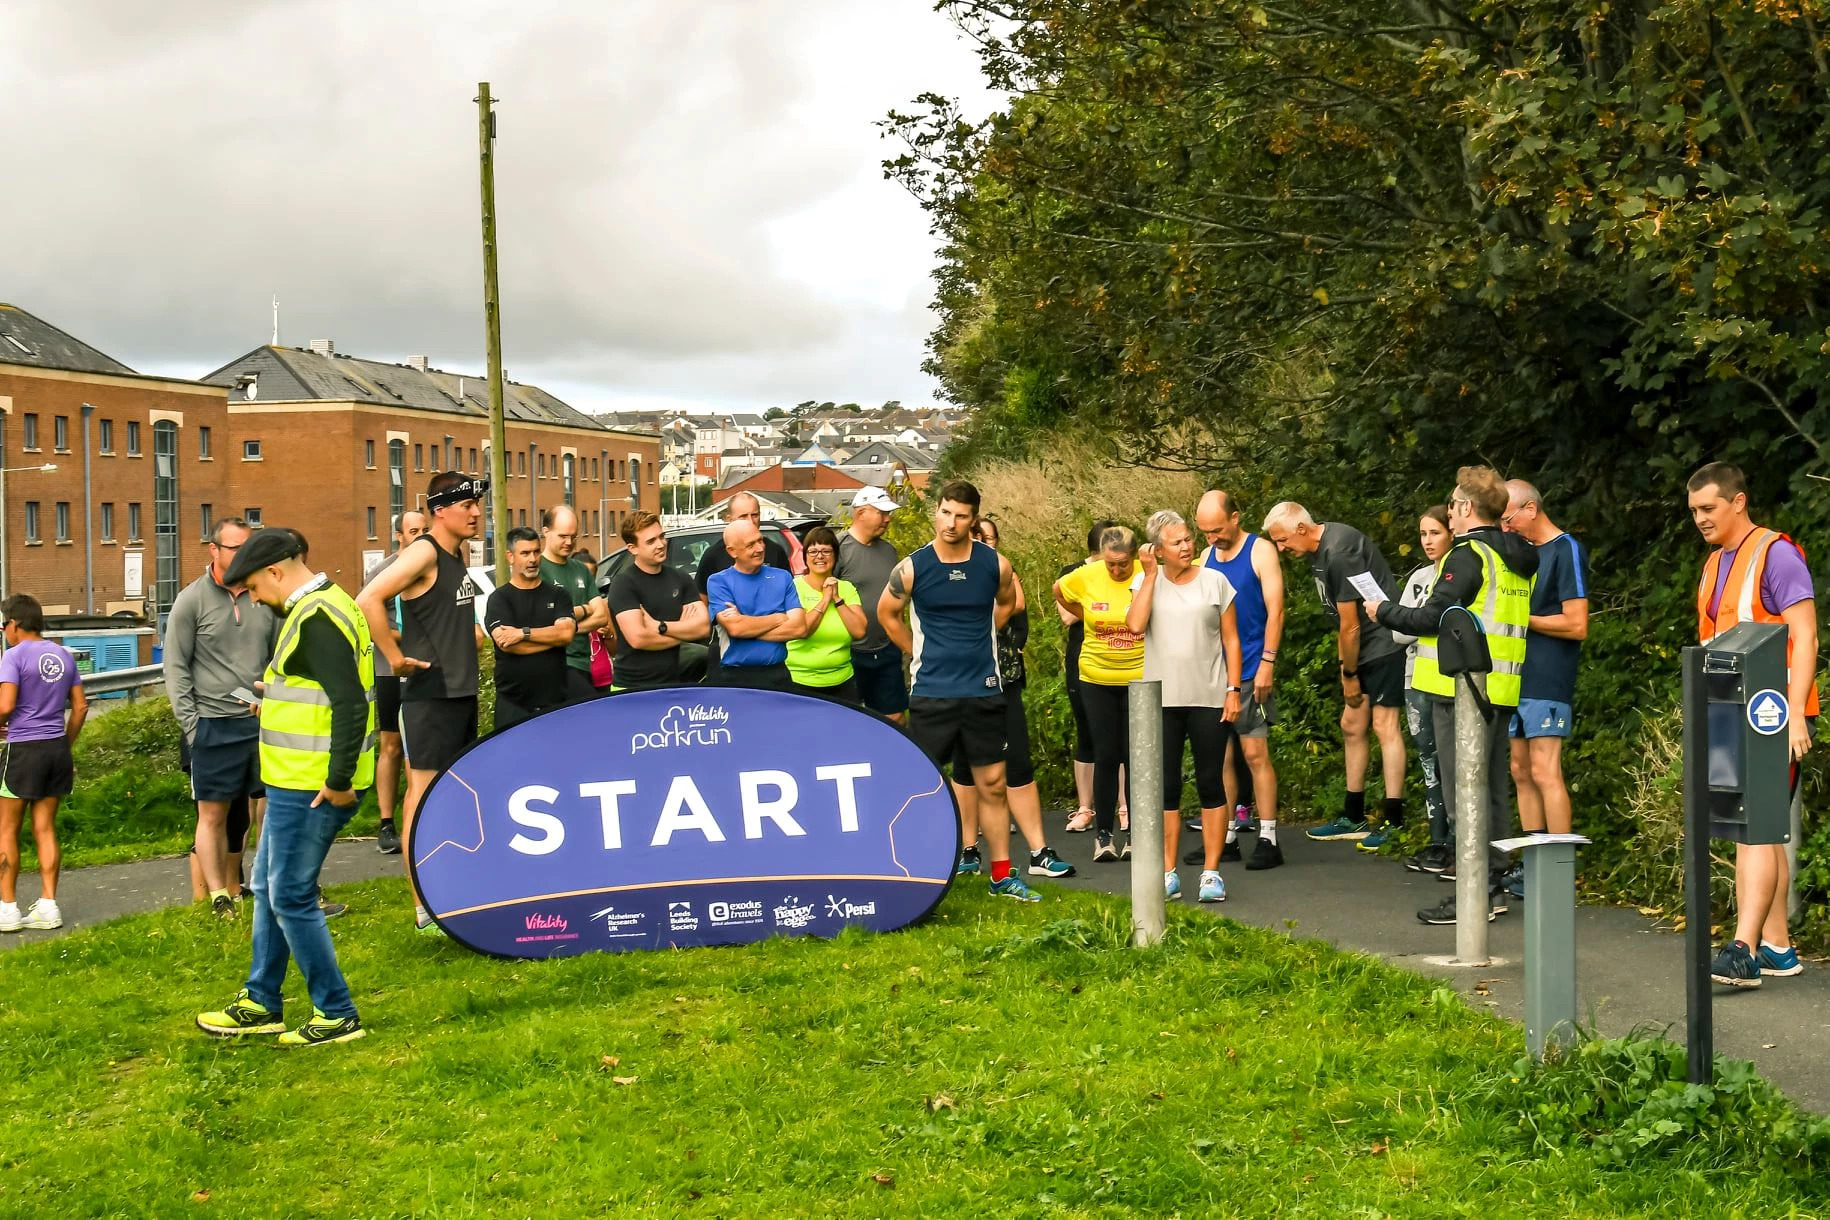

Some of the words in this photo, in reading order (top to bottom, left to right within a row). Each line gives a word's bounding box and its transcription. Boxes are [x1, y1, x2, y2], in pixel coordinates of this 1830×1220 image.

[48, 665, 60, 675] 25
[688, 703, 729, 725] Vitality
[631, 719, 732, 755] parkrun
[507, 762, 872, 855] START
[729, 900, 762, 910] exodus
[844, 901, 875, 918] Persil
[607, 912, 646, 920] Alzheimer's
[730, 908, 763, 919] travels
[773, 903, 815, 920] happy
[525, 912, 568, 932] Vitality
[607, 918, 638, 926] Research
[670, 917, 699, 925] Building
[670, 923, 698, 931] Society
